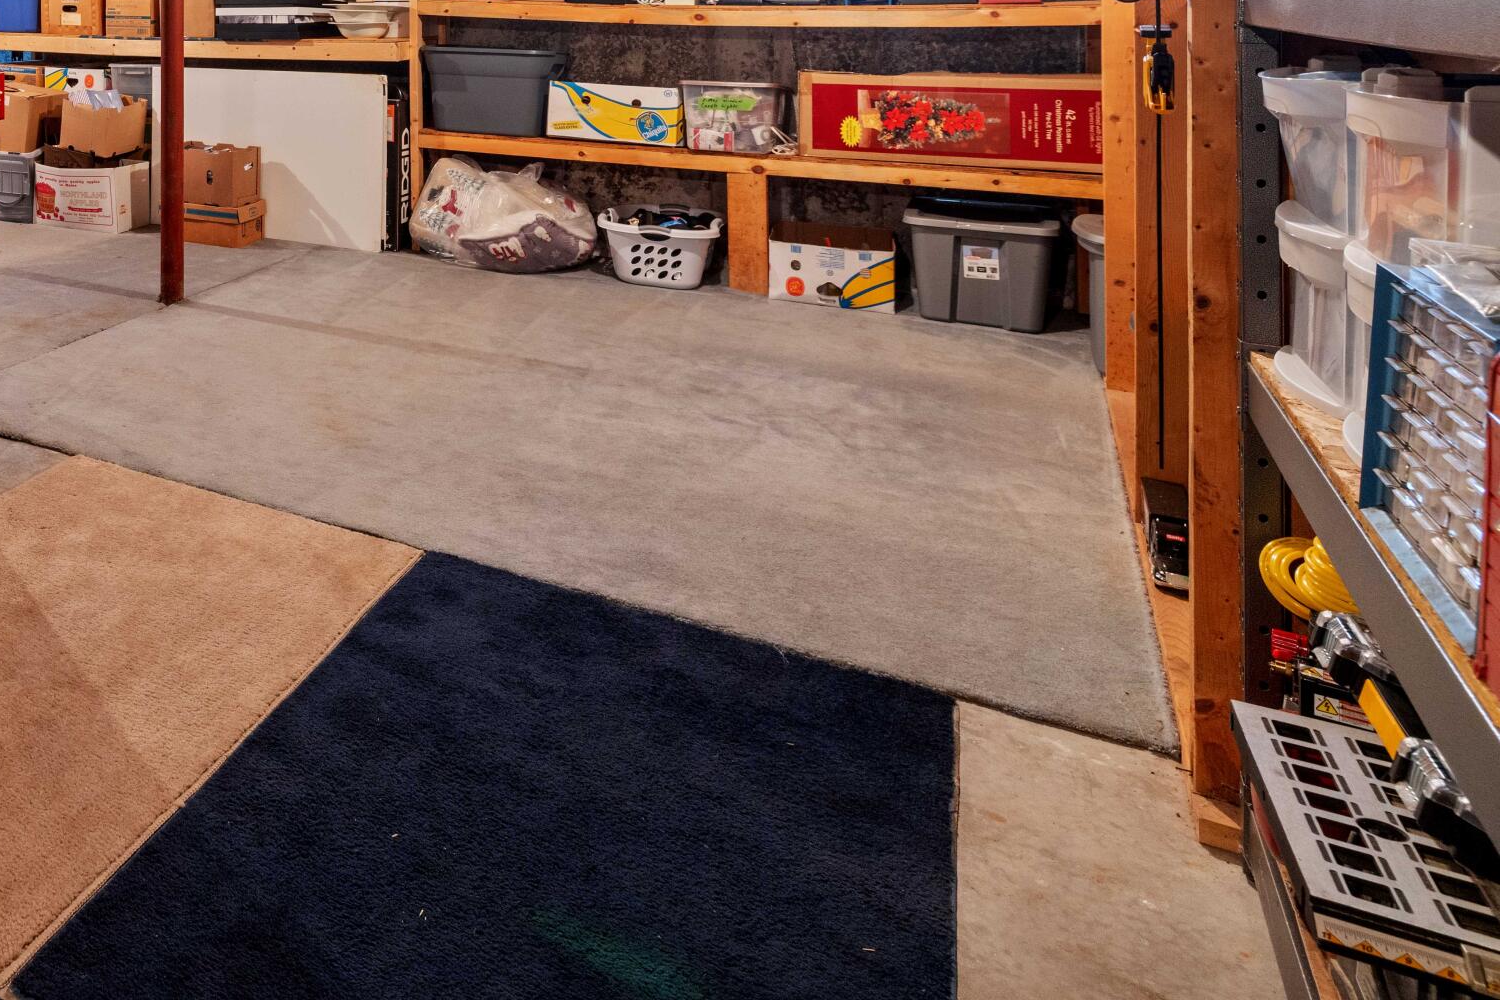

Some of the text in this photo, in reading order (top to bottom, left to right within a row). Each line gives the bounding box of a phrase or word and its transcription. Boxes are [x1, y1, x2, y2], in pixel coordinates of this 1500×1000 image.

[1065, 109, 1076, 120] 42
[642, 125, 668, 139] Chiquita
[401, 128, 410, 225] RIDGID
[60, 191, 107, 200] NORTHLAND
[1361, 943, 1373, 953] 10
